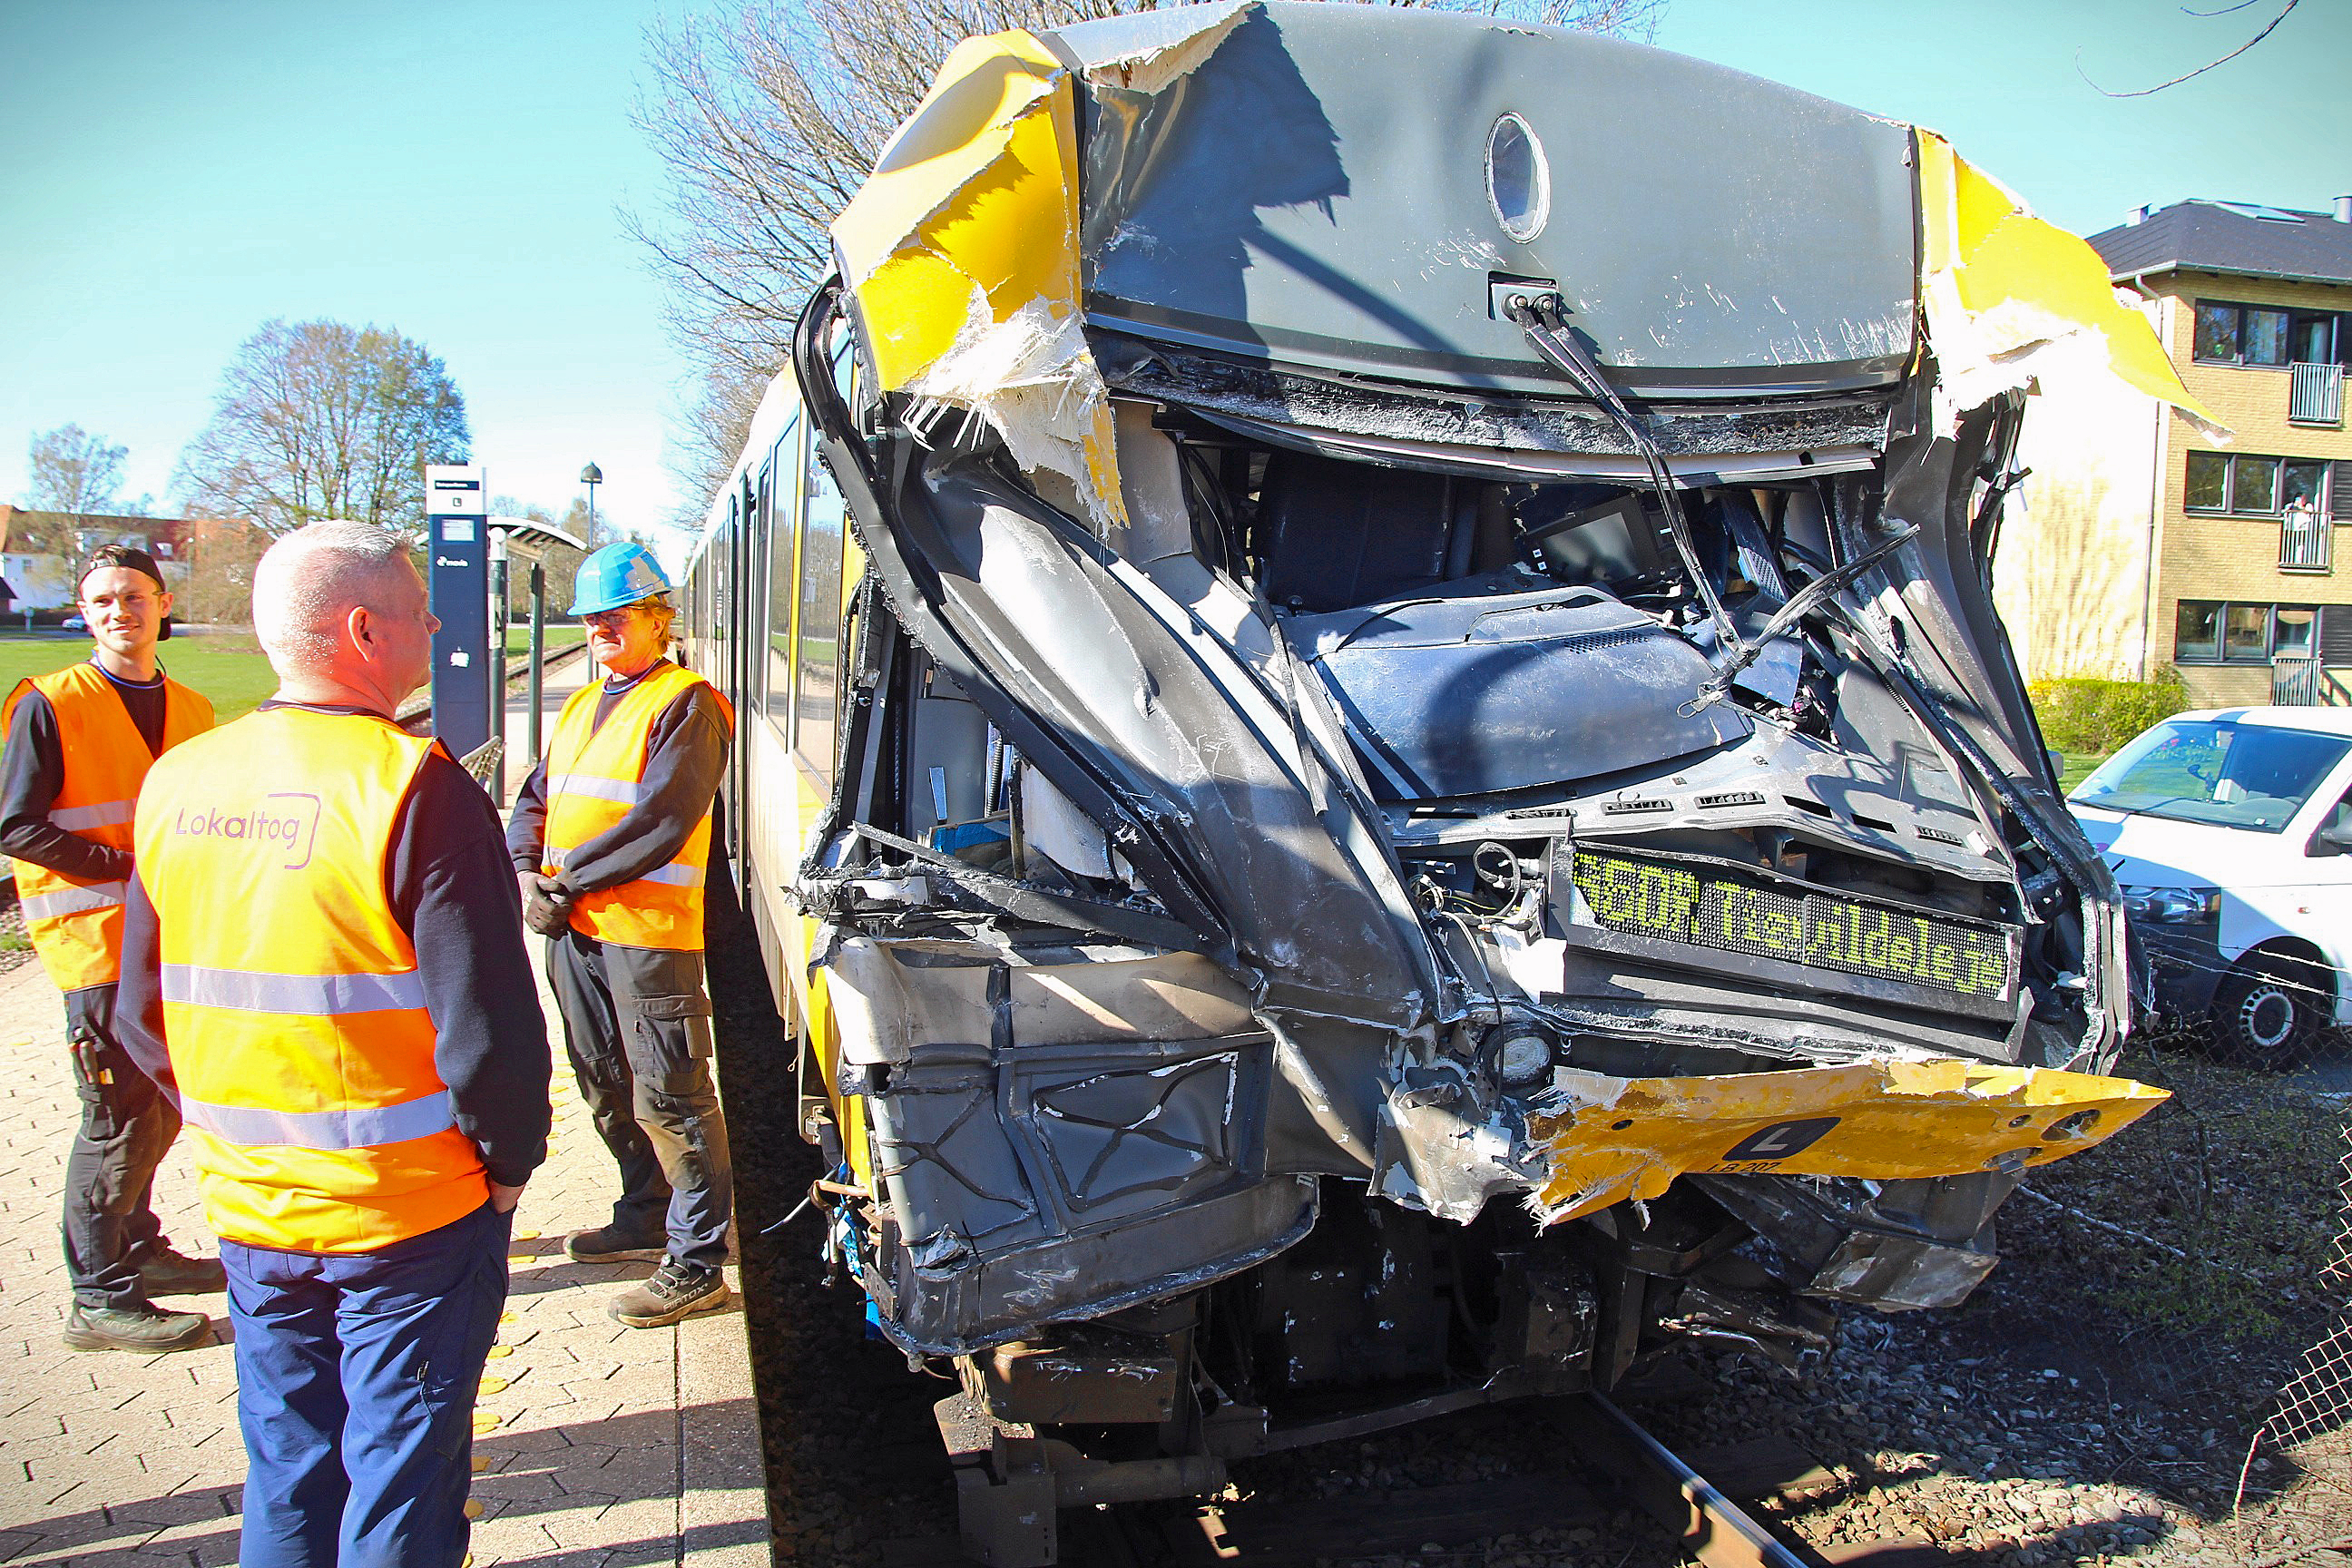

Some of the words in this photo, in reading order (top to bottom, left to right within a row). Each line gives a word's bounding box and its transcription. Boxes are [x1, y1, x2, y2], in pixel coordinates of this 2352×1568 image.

[174, 807, 301, 850] Lokaltog
[1749, 1126, 1792, 1152] L
[1740, 1161, 1783, 1172] 207
[663, 1284, 705, 1310] AIRTOX
